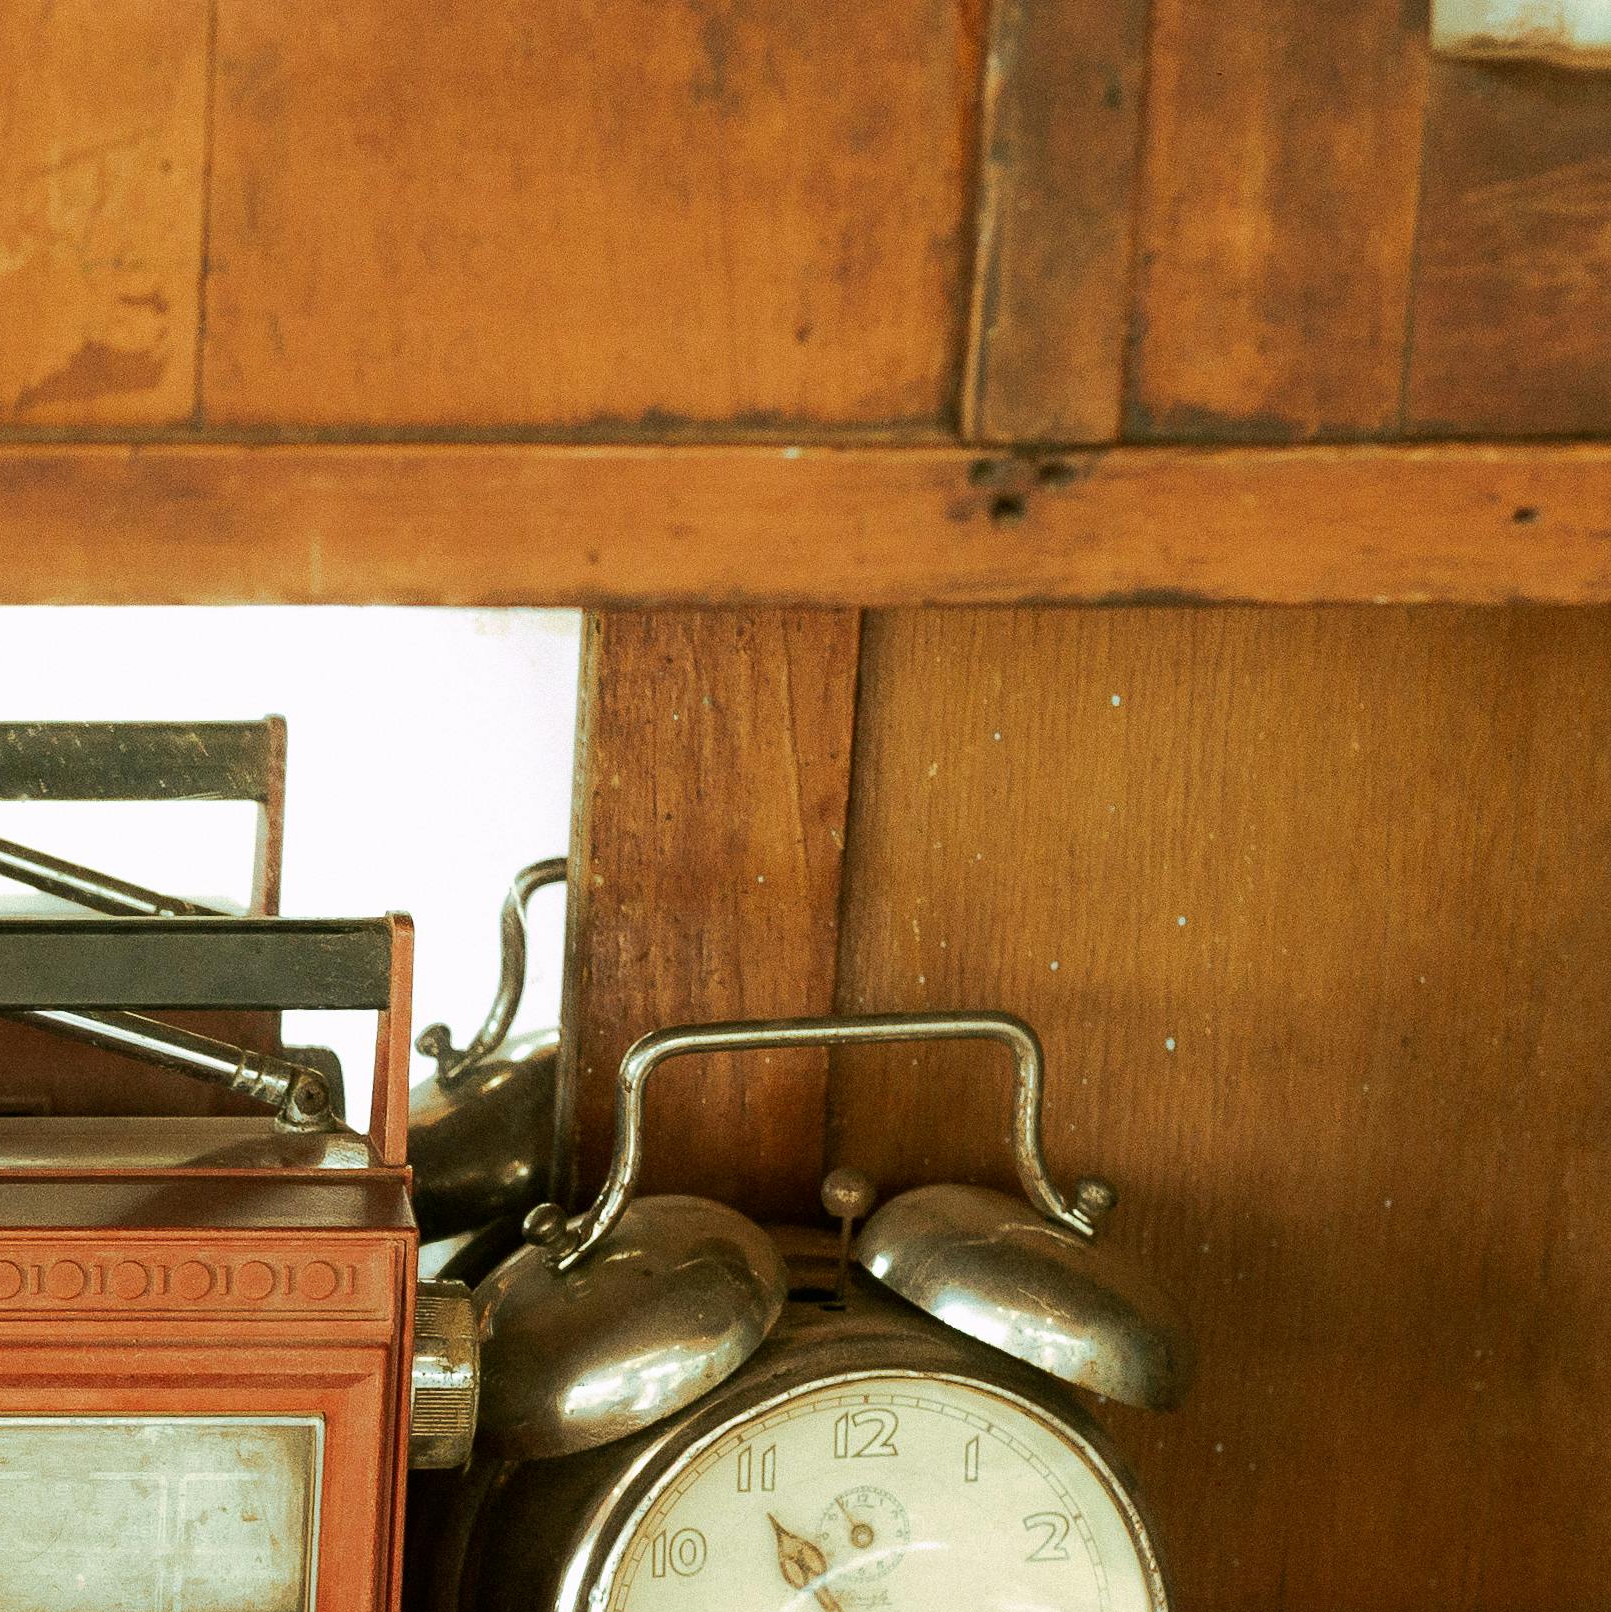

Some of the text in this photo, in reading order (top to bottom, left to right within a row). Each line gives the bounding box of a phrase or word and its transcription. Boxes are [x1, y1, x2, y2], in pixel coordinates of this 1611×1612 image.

[834, 1408, 898, 1459] 12
[737, 1443, 778, 1493] 11
[964, 1436, 980, 1484] 1
[651, 1528, 708, 1579] 10
[1024, 1512, 1070, 1562] 2
